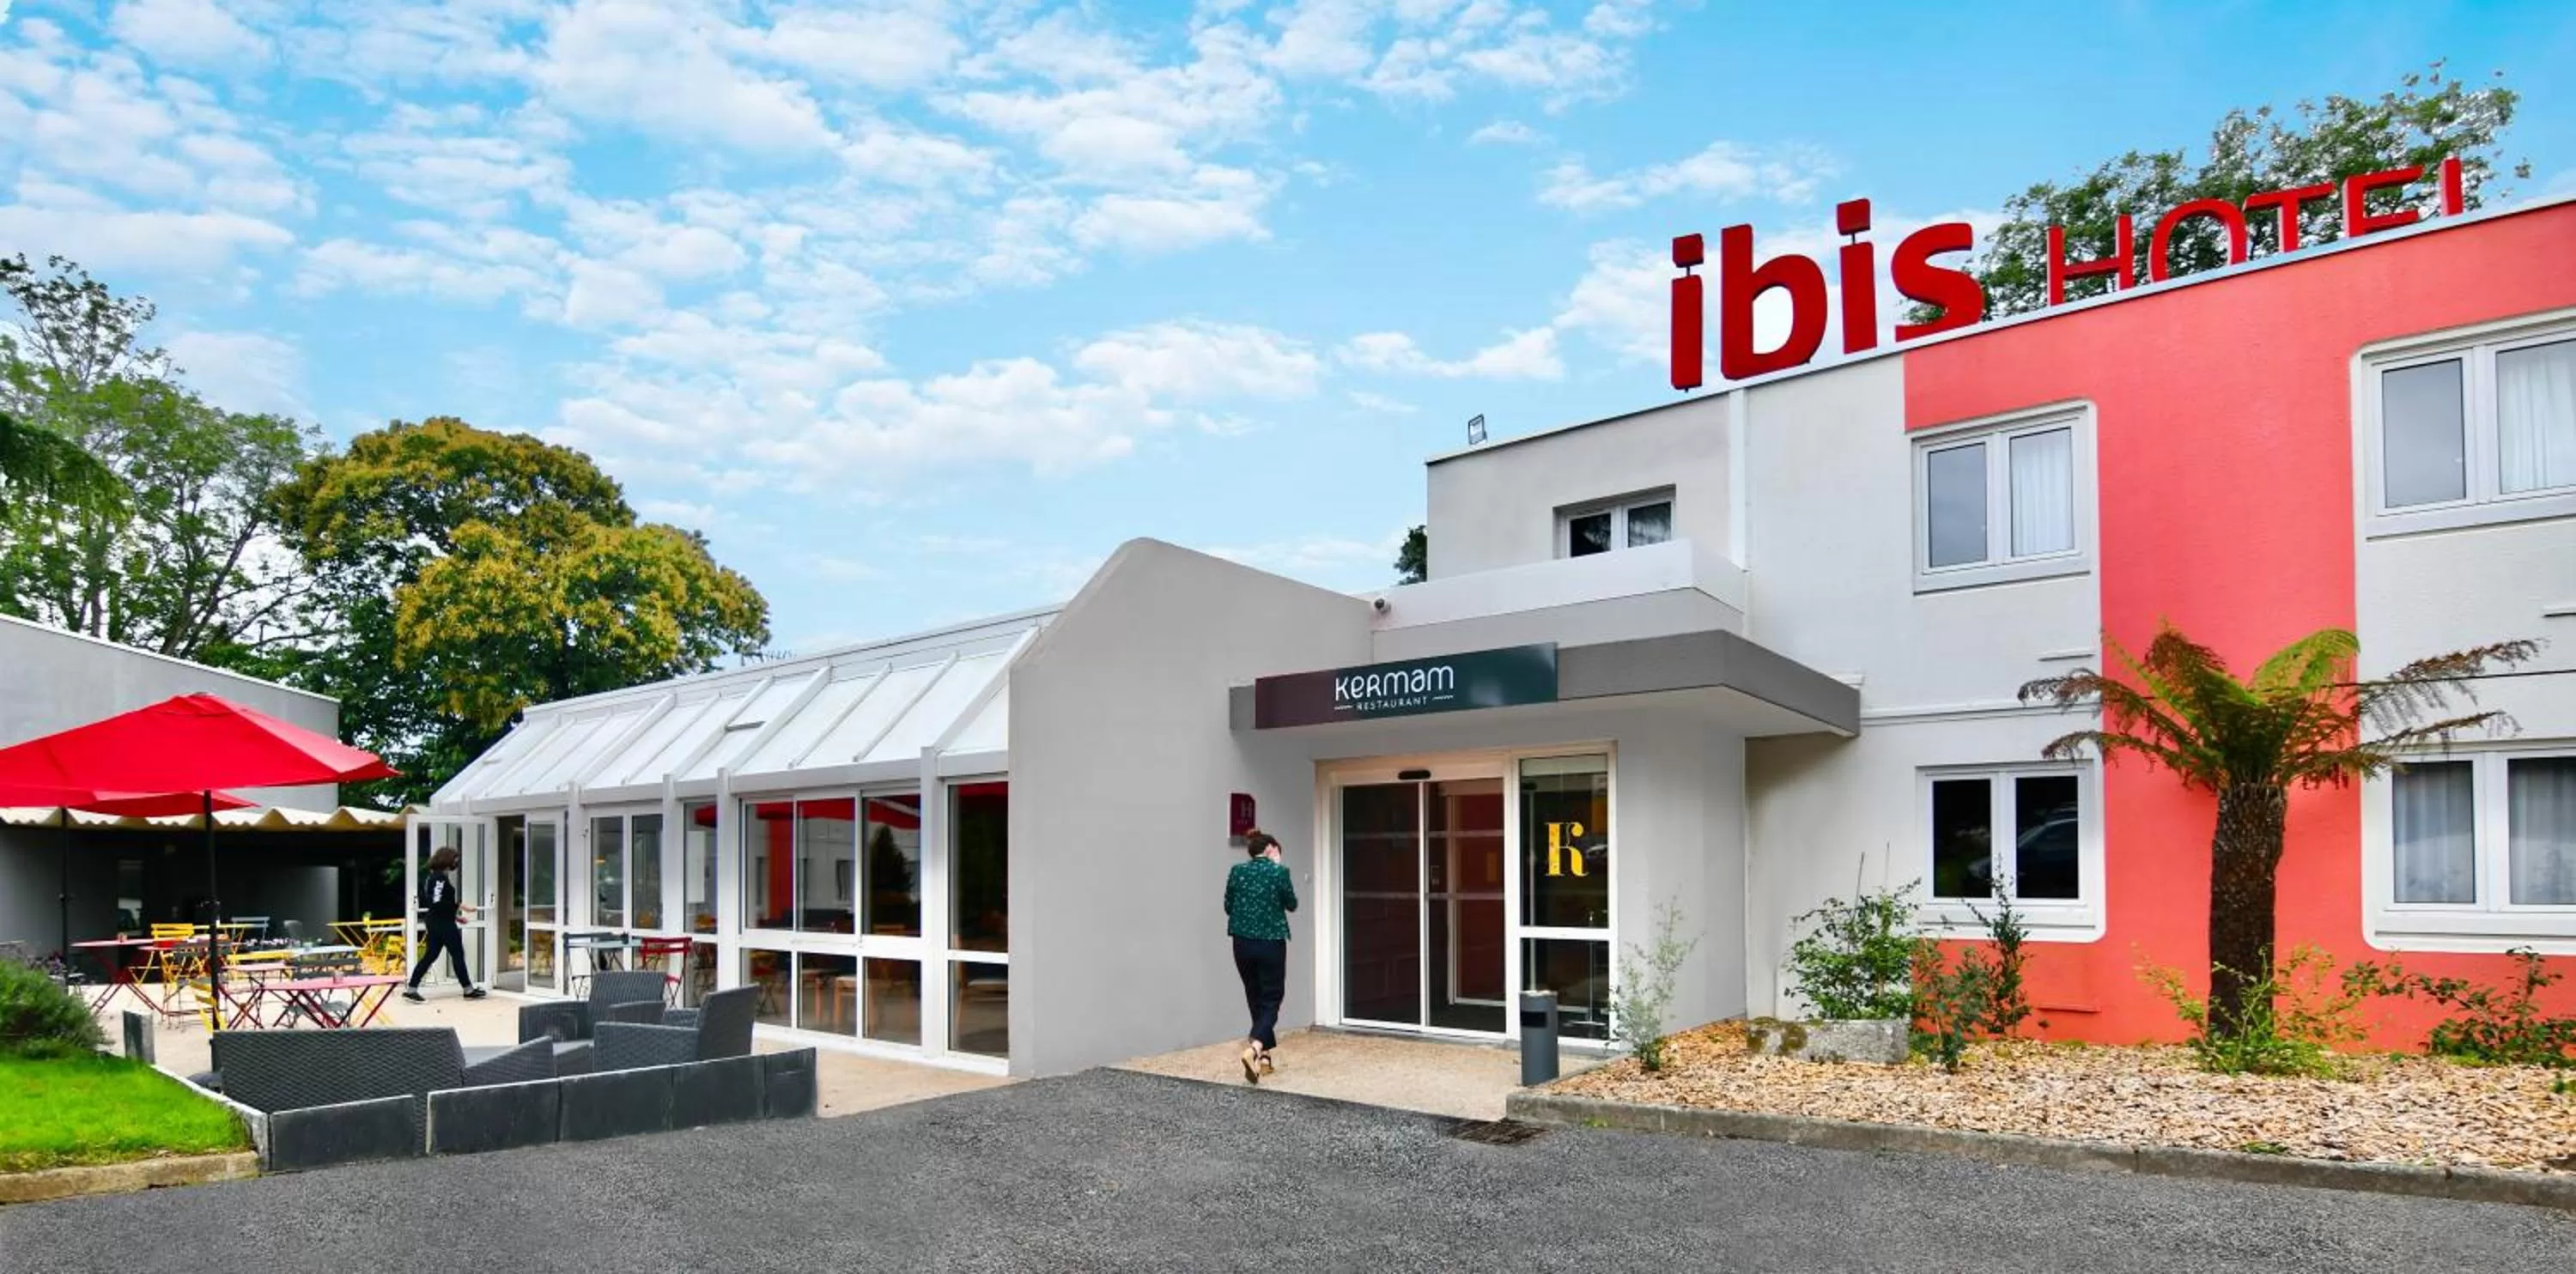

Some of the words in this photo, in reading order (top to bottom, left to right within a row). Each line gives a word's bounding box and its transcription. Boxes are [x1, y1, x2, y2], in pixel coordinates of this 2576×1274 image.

[1671, 197, 1985, 390] ibis
[1356, 696, 1427, 711] RESTAURANT
[1545, 822, 1589, 877] K
